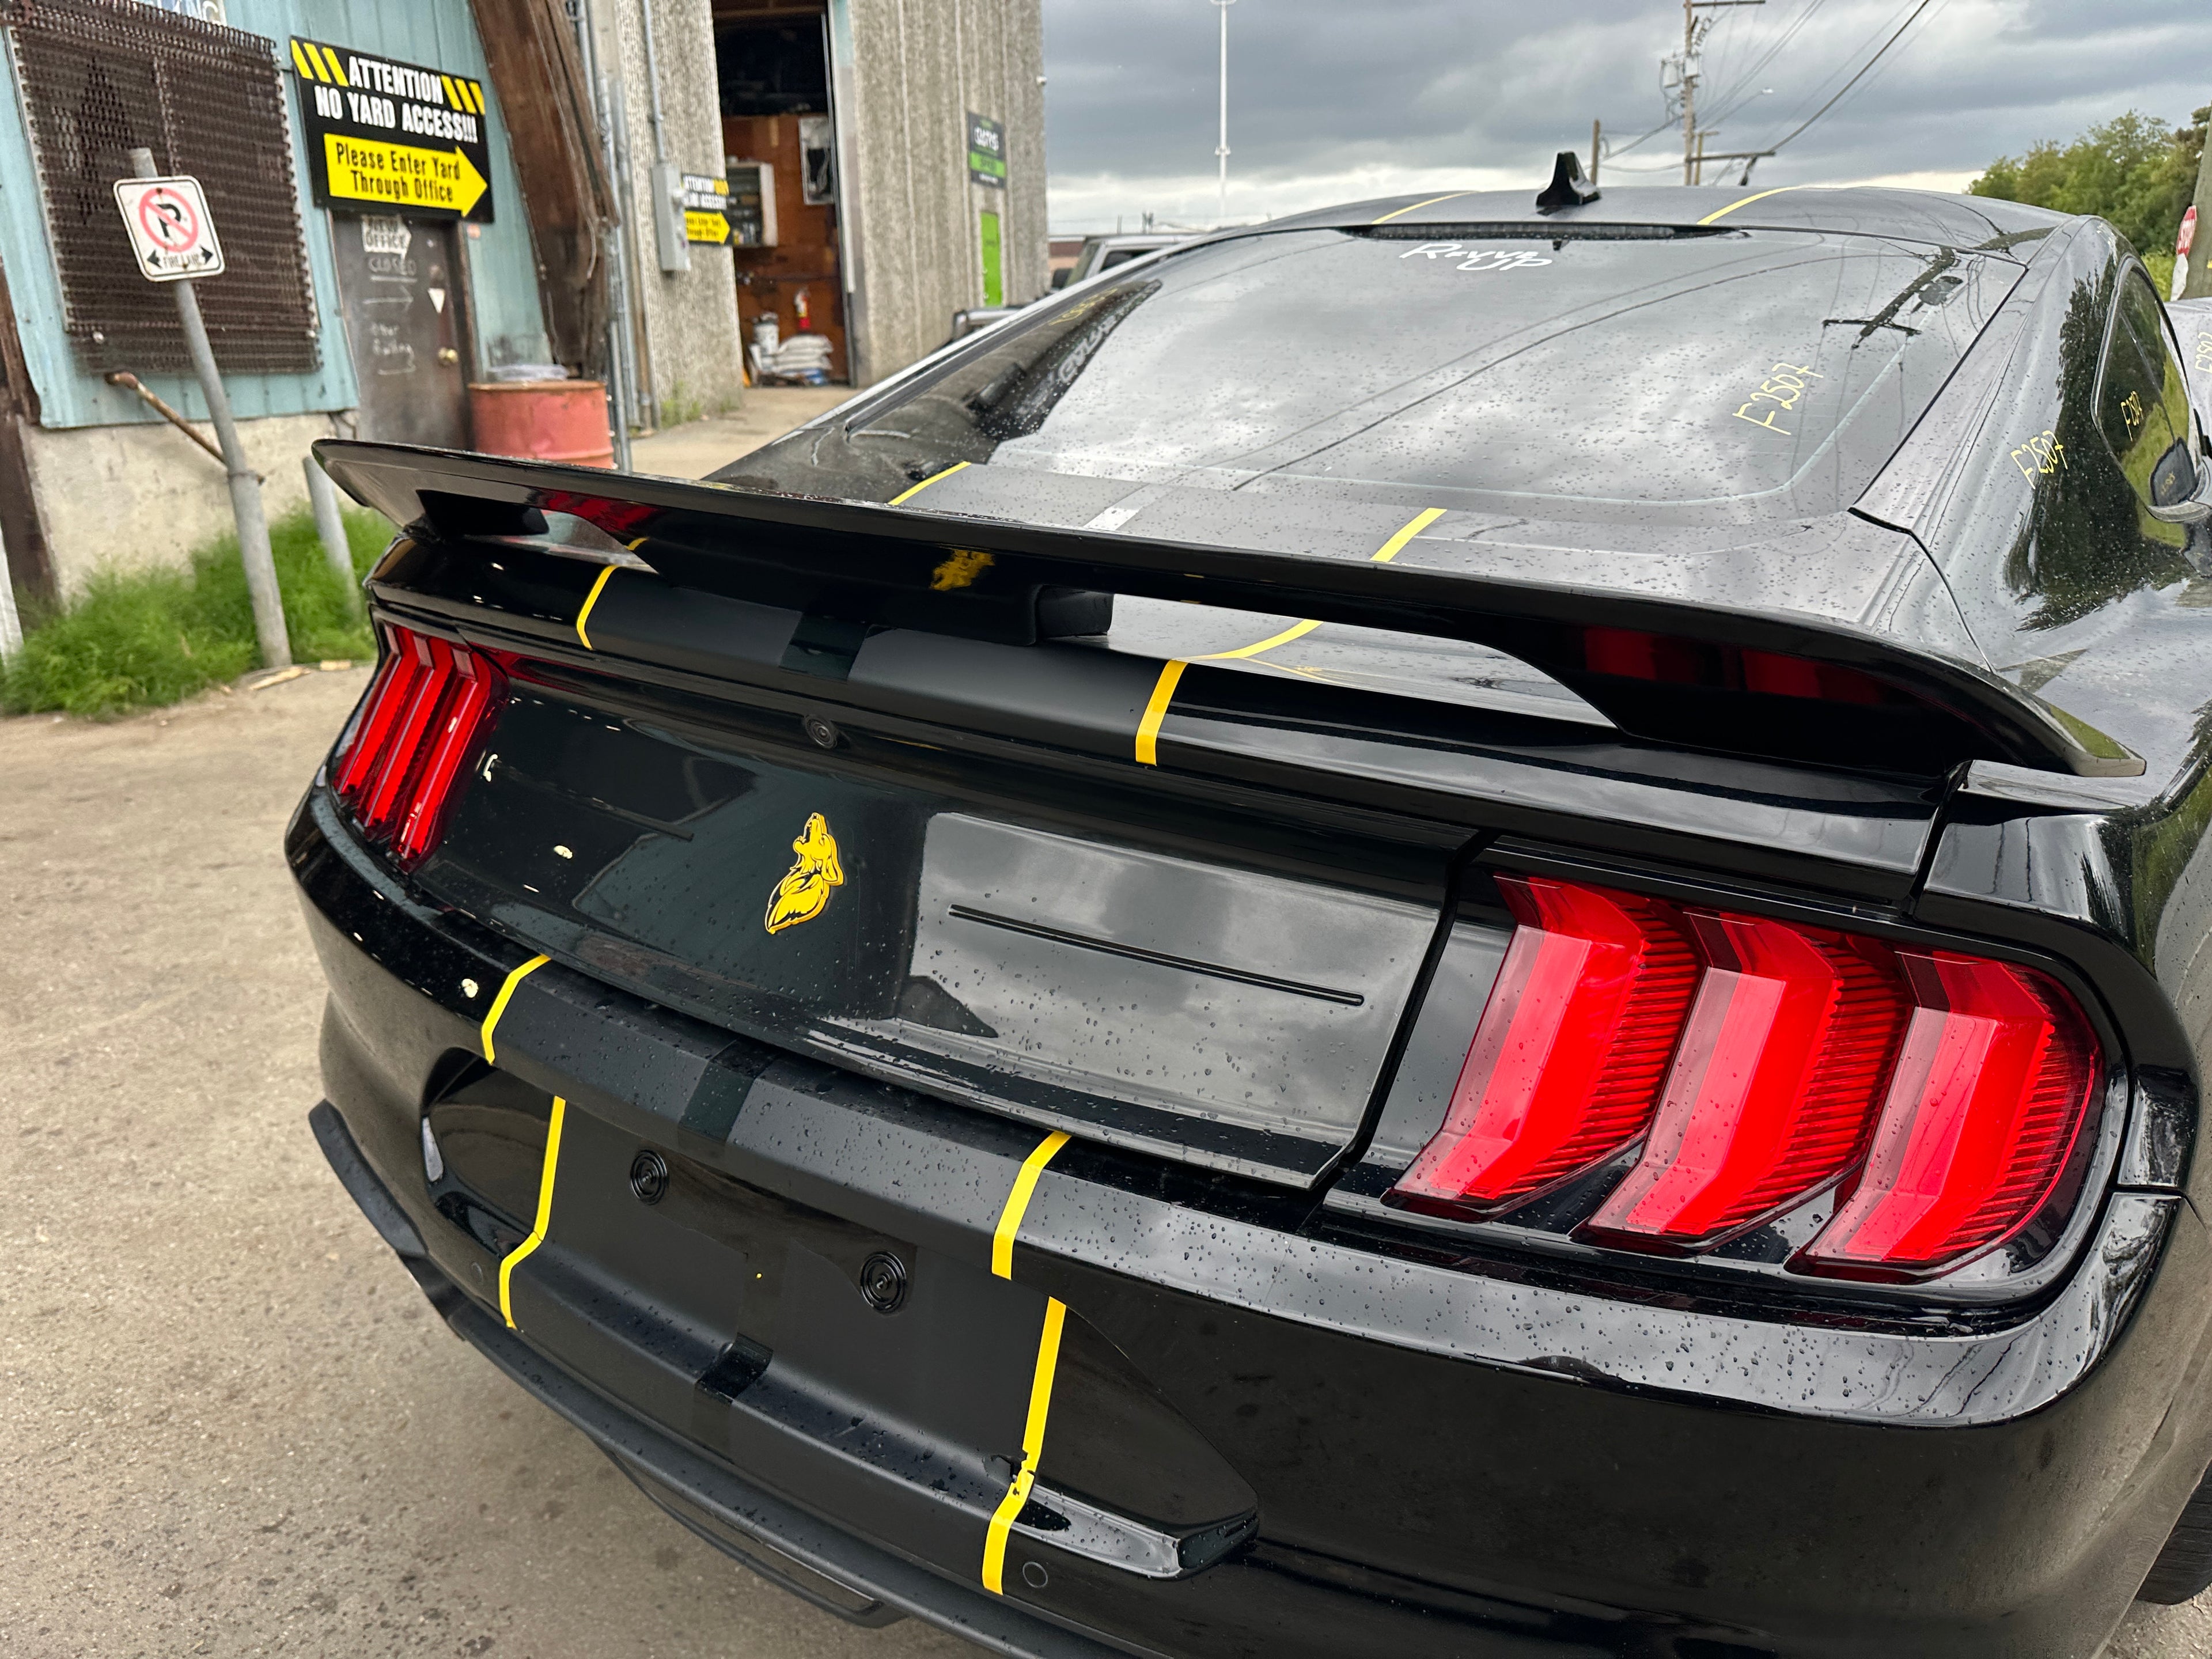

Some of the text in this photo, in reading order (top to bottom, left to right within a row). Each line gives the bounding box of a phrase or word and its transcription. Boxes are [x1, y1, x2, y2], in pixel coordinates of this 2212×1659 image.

[349, 55, 444, 105] ATTENTION
[315, 85, 478, 143] NO YARD ACCESS!!!
[336, 142, 460, 180] Please Enter Yard
[350, 170, 453, 202] Through Office
[1732, 363, 1824, 435] F2507
[2010, 430, 2068, 490] F2507
